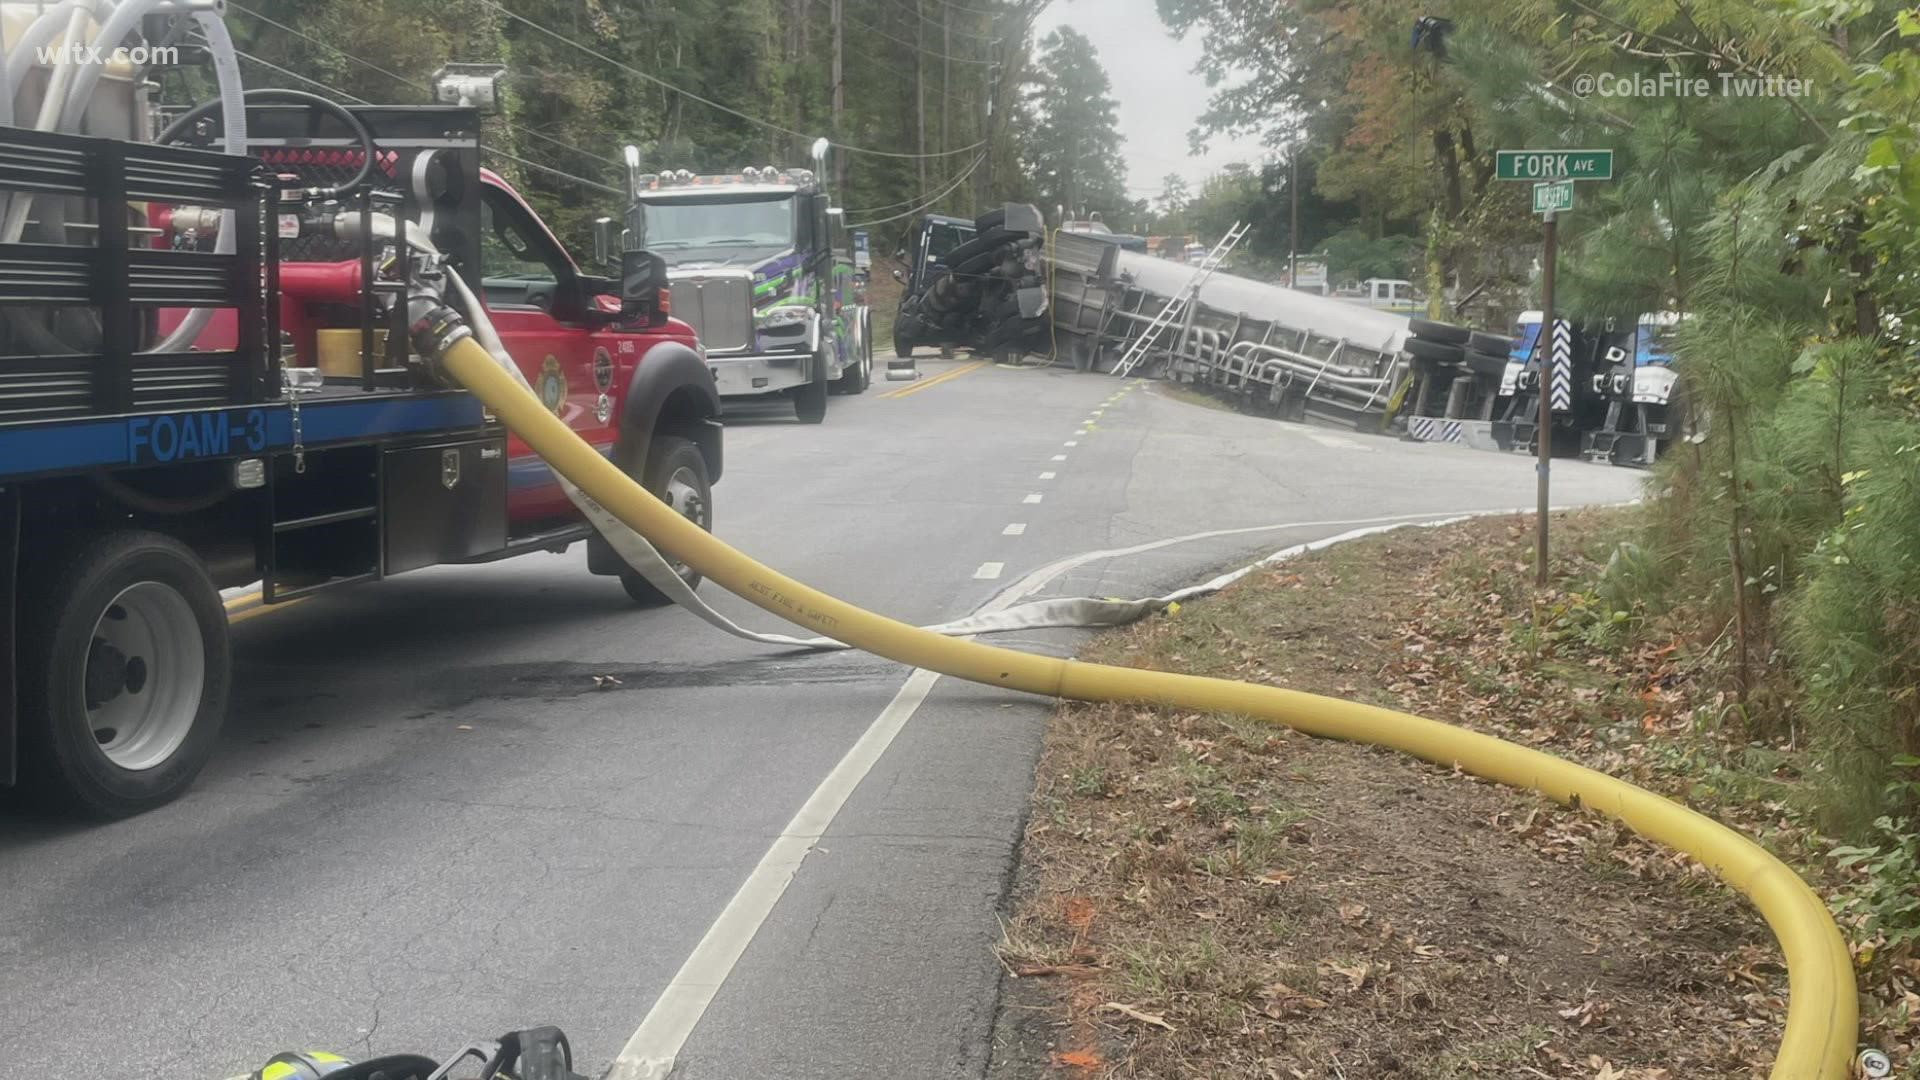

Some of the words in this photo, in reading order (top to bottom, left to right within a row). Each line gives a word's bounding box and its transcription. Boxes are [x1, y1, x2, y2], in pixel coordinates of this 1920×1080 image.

[1513, 154, 1569, 177] FORK
[1573, 159, 1595, 172] AVE
[128, 409, 266, 464] FOAM-3
